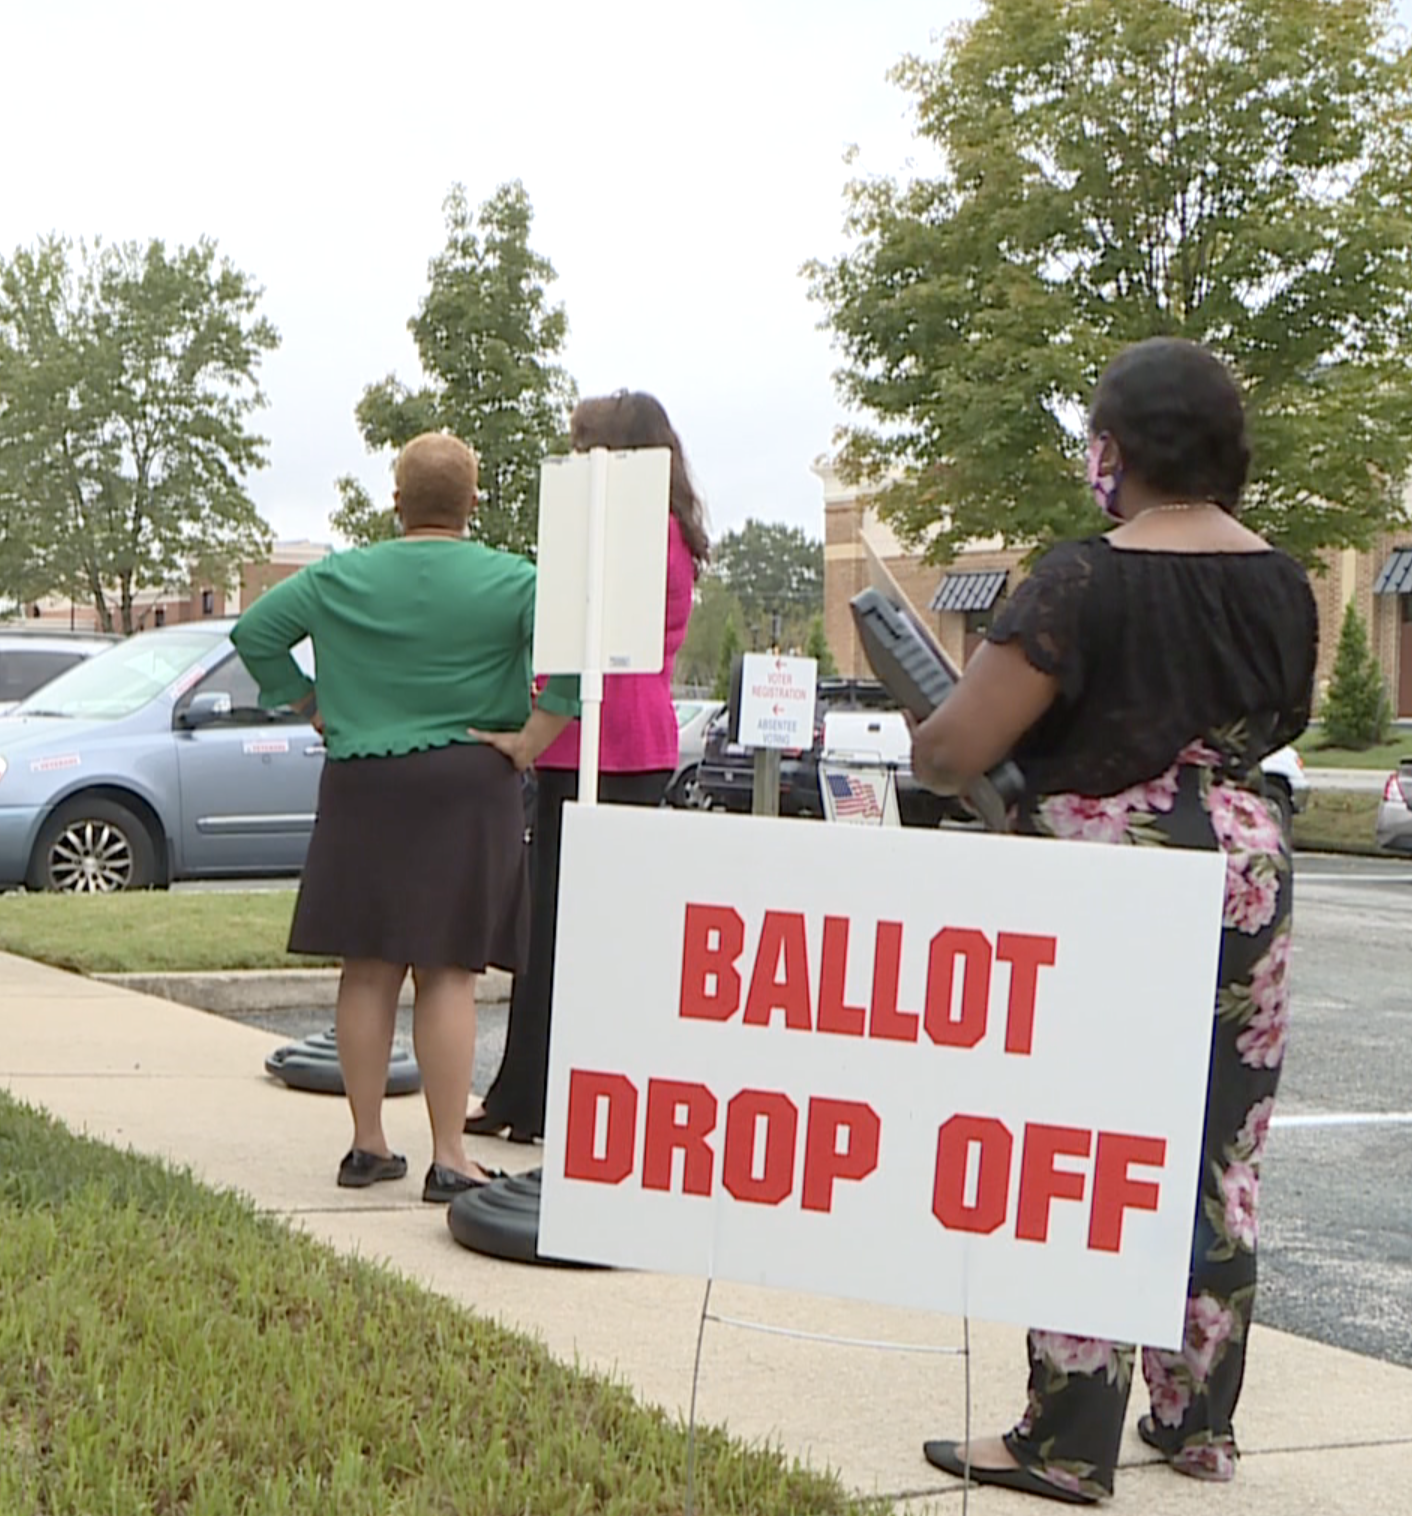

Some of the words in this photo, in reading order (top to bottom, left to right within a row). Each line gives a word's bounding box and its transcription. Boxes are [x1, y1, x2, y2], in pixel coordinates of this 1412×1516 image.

[768, 674, 792, 685] VOTER
[752, 685, 806, 700] REGISTRATION
[757, 718, 797, 732] ABSENTEE
[679, 902, 1058, 1056] BALLOT
[564, 1068, 881, 1214] DROP
[931, 1113, 1167, 1253] OFF
